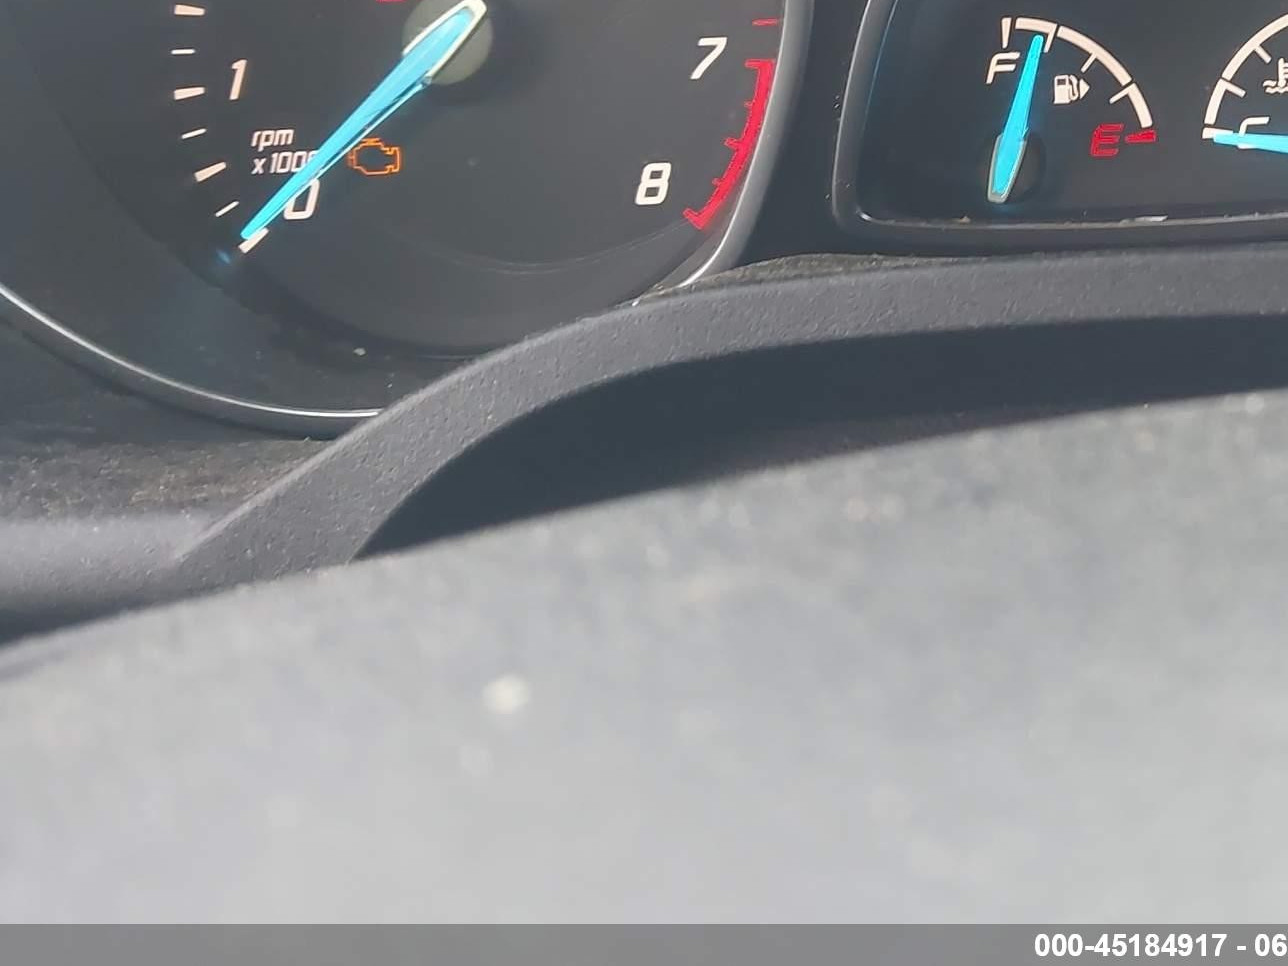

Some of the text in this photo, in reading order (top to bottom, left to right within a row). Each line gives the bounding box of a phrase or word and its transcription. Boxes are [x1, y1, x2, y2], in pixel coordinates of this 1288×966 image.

[690, 37, 728, 80] 7
[985, 51, 1021, 85] F
[230, 60, 248, 101] 1
[250, 128, 295, 152] rpm
[1090, 122, 1125, 157] E
[250, 157, 268, 175] x
[635, 162, 672, 205] 8
[283, 177, 321, 220] 0
